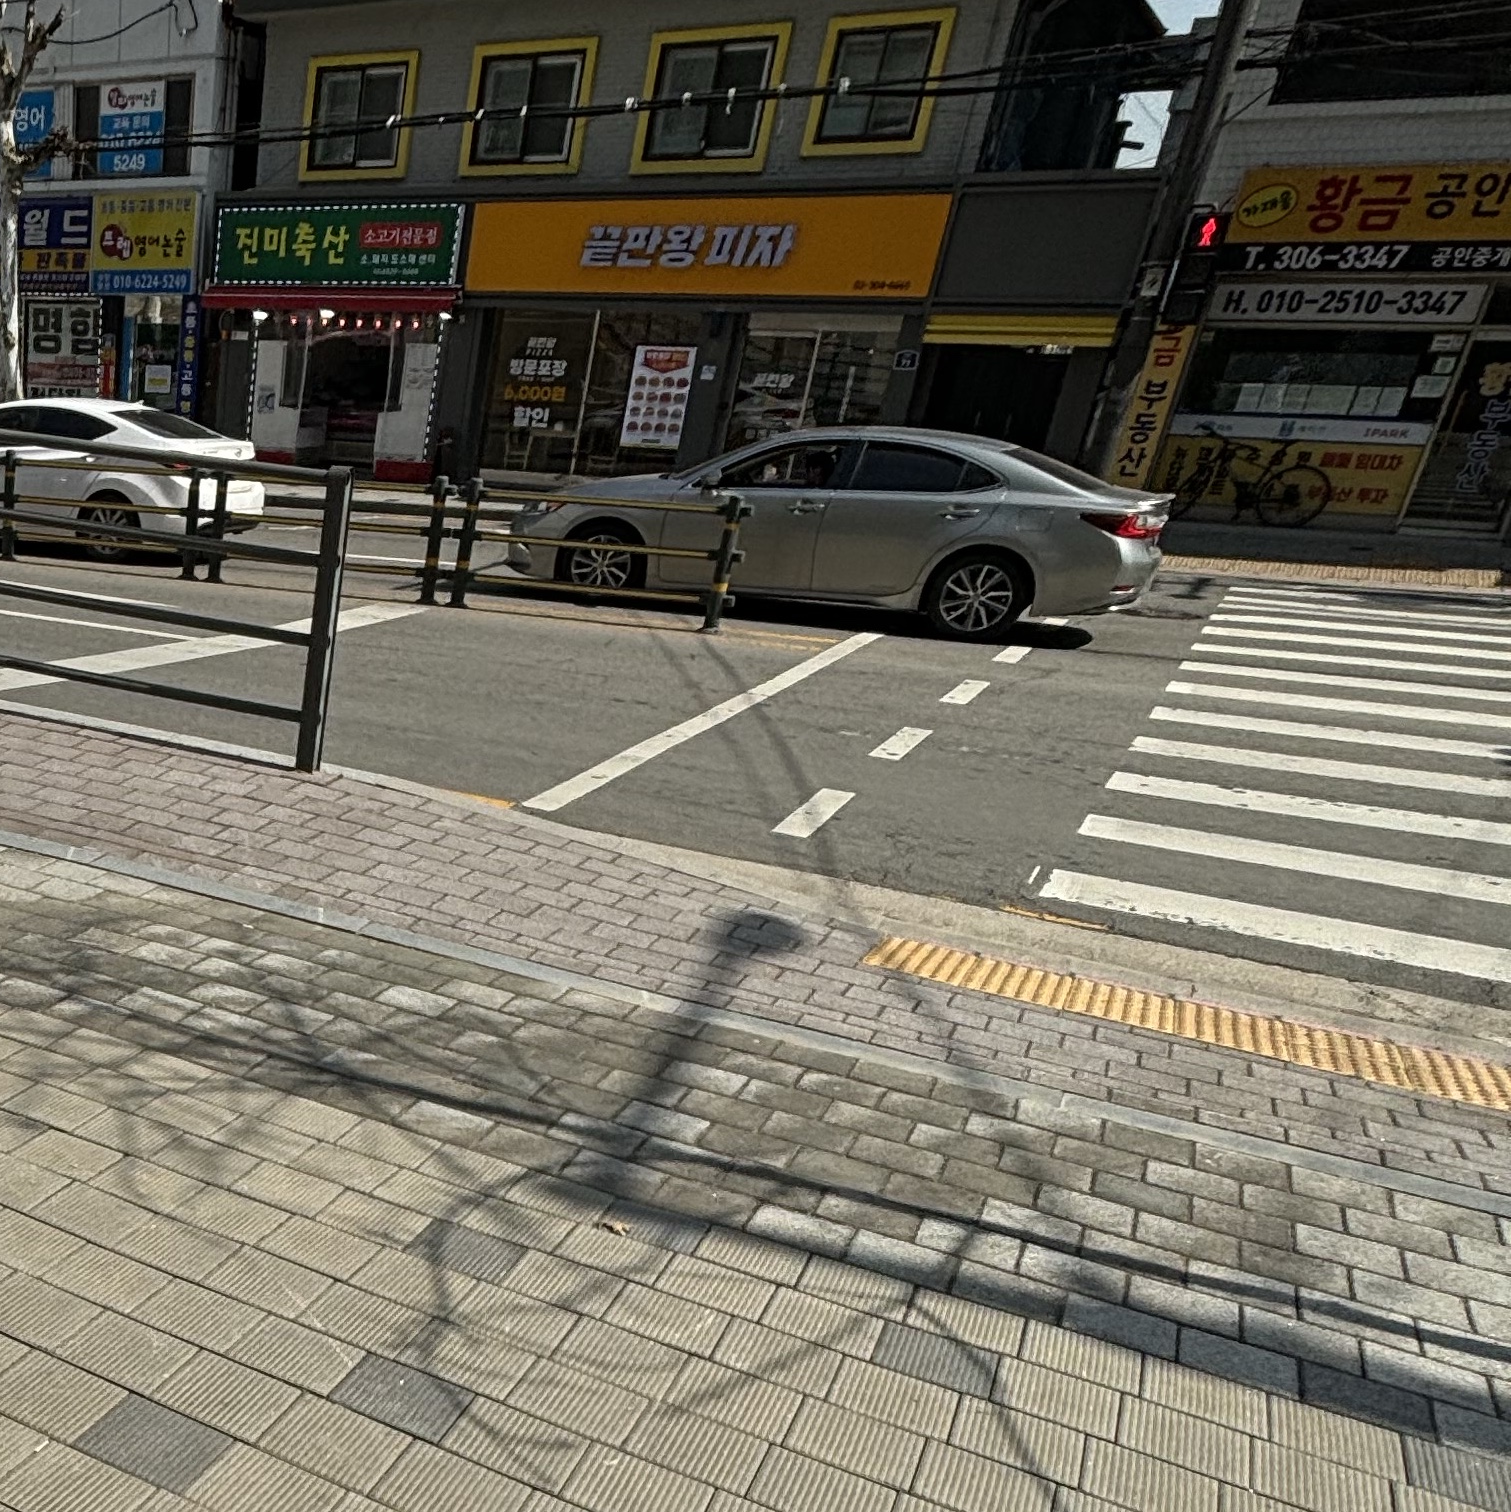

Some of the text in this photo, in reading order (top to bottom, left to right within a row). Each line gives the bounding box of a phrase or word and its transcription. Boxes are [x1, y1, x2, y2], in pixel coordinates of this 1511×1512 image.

[113, 153, 146, 171] 5249
[1305, 173, 1414, 234] 황금
[134, 228, 187, 257] 영어논술
[235, 220, 350, 267] 진미축산
[580, 223, 797, 269] 끝판왕 피자
[1244, 244, 1411, 271] T. 306-3347
[1222, 289, 1469, 316] H. 010-2510-3347
[509, 358, 568, 377] 방문포장
[512, 405, 551, 429] 할인
[1118, 379, 1170, 477] 부동산
[1362, 426, 1411, 440] IPARK
